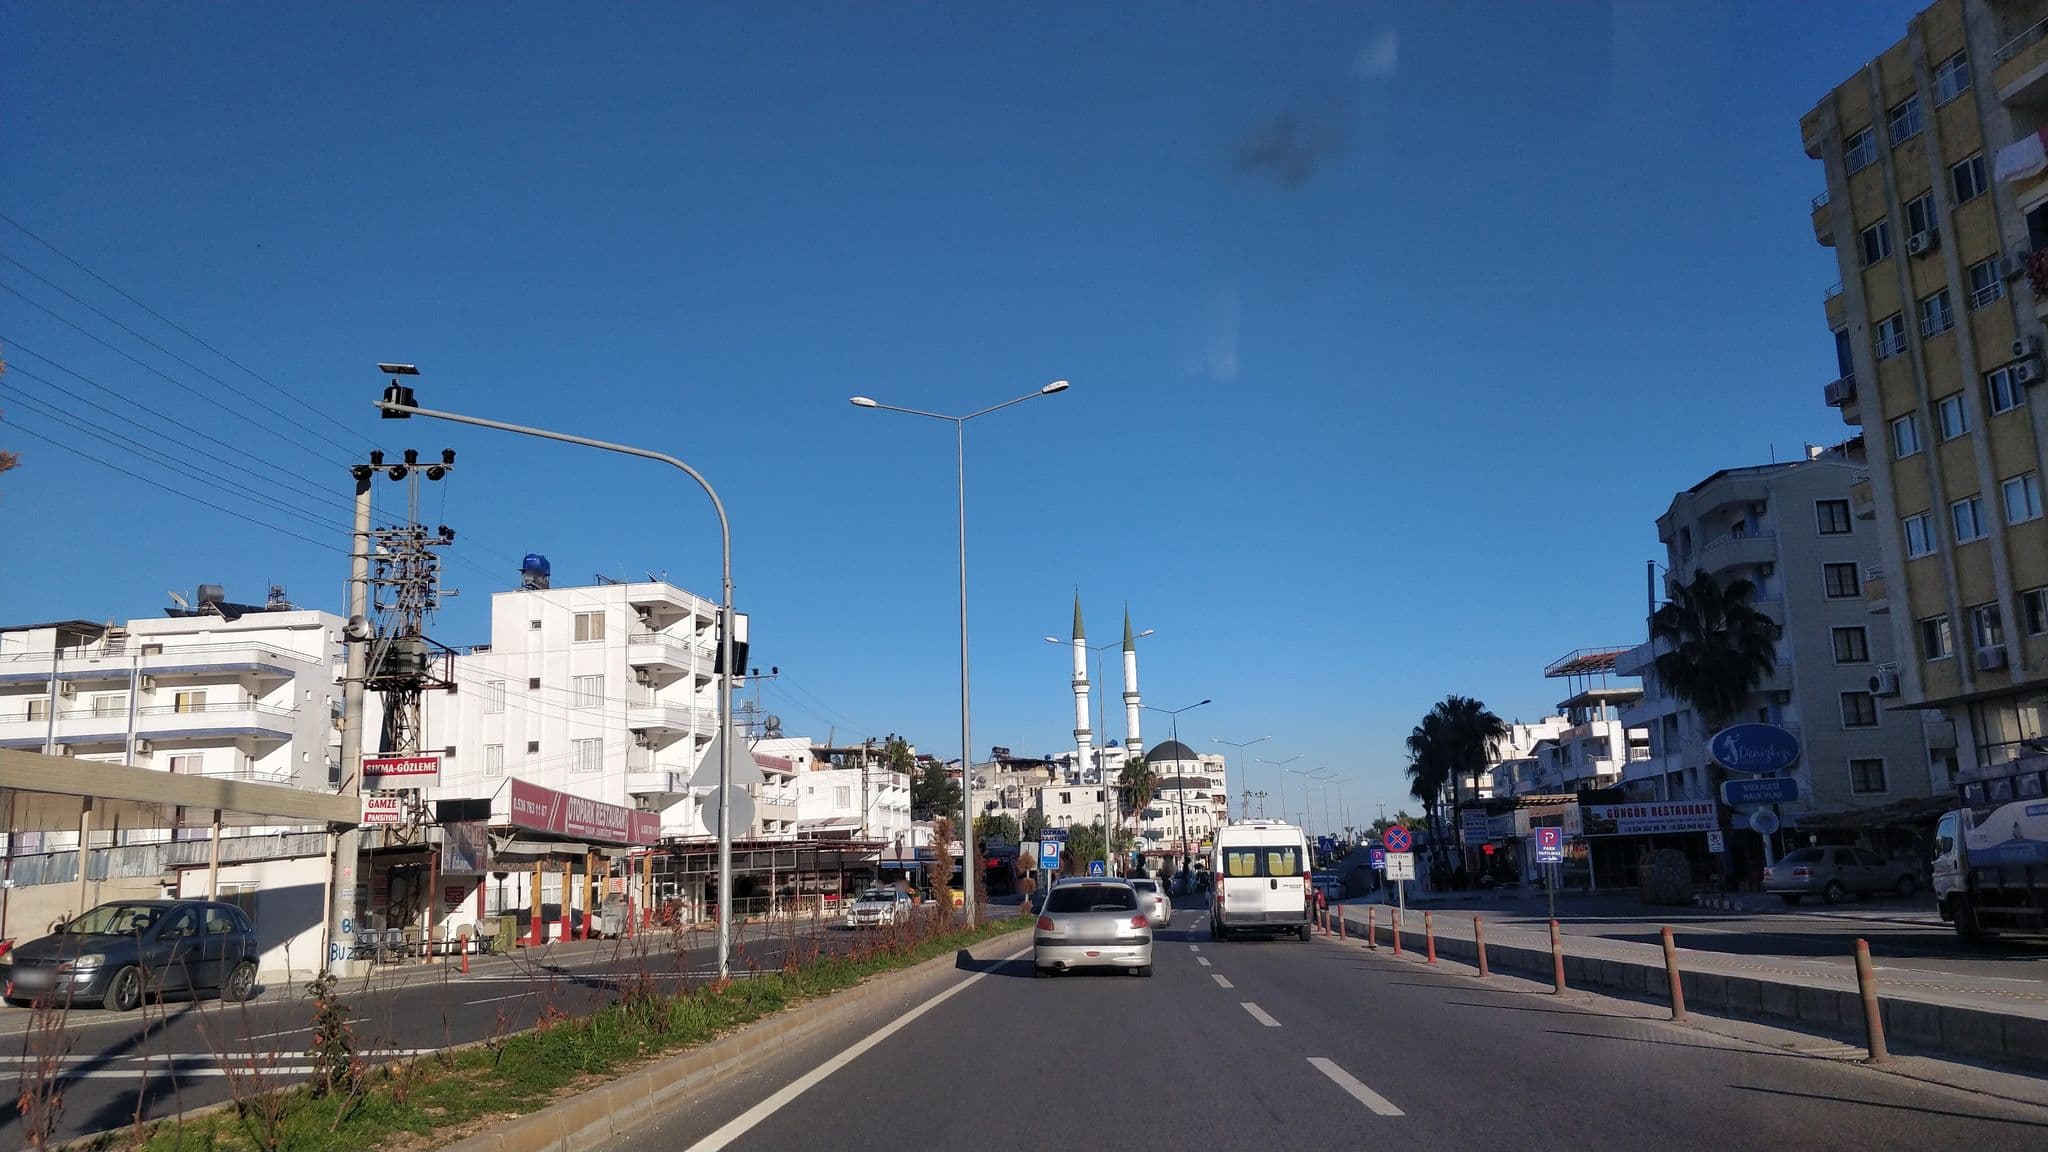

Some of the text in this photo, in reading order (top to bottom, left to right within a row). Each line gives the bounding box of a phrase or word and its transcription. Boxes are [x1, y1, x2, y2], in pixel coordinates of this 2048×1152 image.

[368, 799, 397, 809] GAMZE
[1651, 804, 1713, 817] RESTAURANT
[568, 796, 628, 829] OTOPARK RESTAURANT
